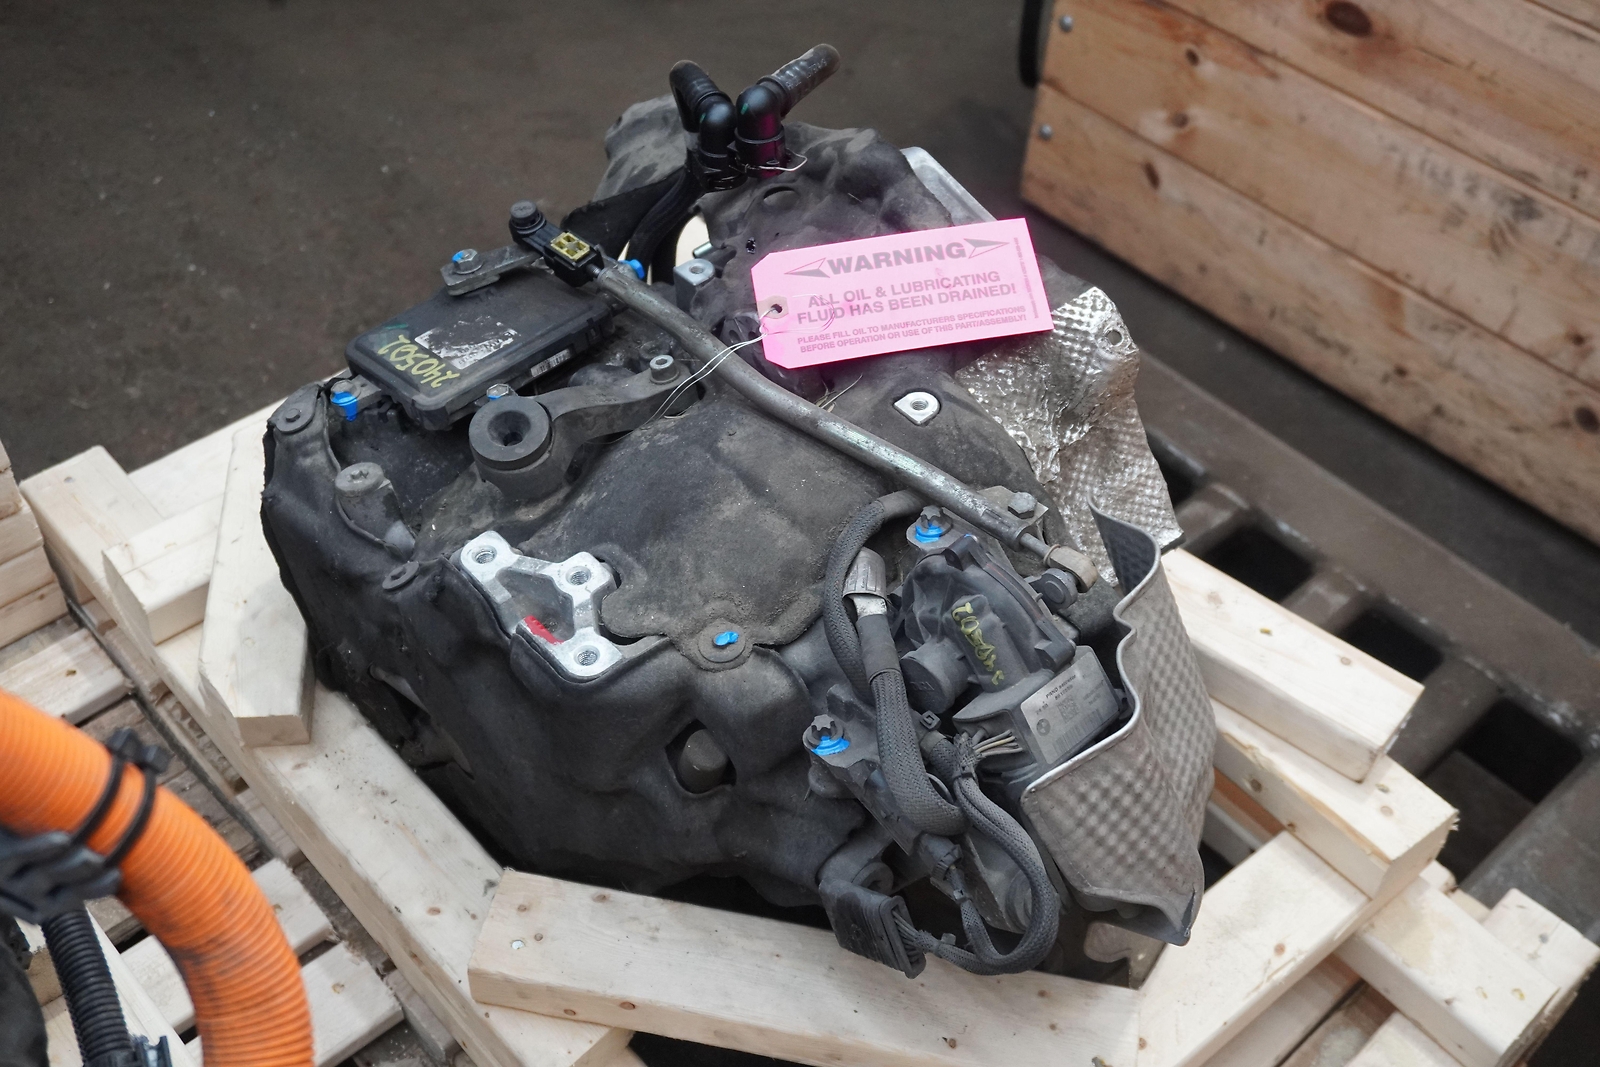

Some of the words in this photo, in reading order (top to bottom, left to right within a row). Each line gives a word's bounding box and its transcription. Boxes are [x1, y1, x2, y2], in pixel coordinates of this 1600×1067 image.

[826, 241, 967, 275] WARNING
[797, 307, 845, 325] FLUID
[849, 301, 885, 317] HAS
[888, 293, 934, 311] BEEN
[937, 283, 1017, 304] DRAINED!
[808, 293, 840, 308] ALL
[843, 288, 871, 303] OIL
[875, 286, 887, 298] &
[890, 271, 1001, 296] LUBRICATING
[797, 332, 832, 345] PLEASE
[832, 329, 851, 340] FILL
[852, 327, 866, 337] OIL
[867, 325, 879, 334] TO
[881, 314, 956, 332] MANUFACTURERS
[957, 305, 1026, 321] SPECIFICATIONS
[800, 342, 836, 353] BEFORE
[837, 333, 886, 348] OPERATION
[887, 330, 901, 340] OR
[902, 327, 920, 338] USE
[921, 325, 933, 335] OF
[934, 323, 954, 334] THIS
[955, 313, 1027, 330] PART/ASSEMBLY!
